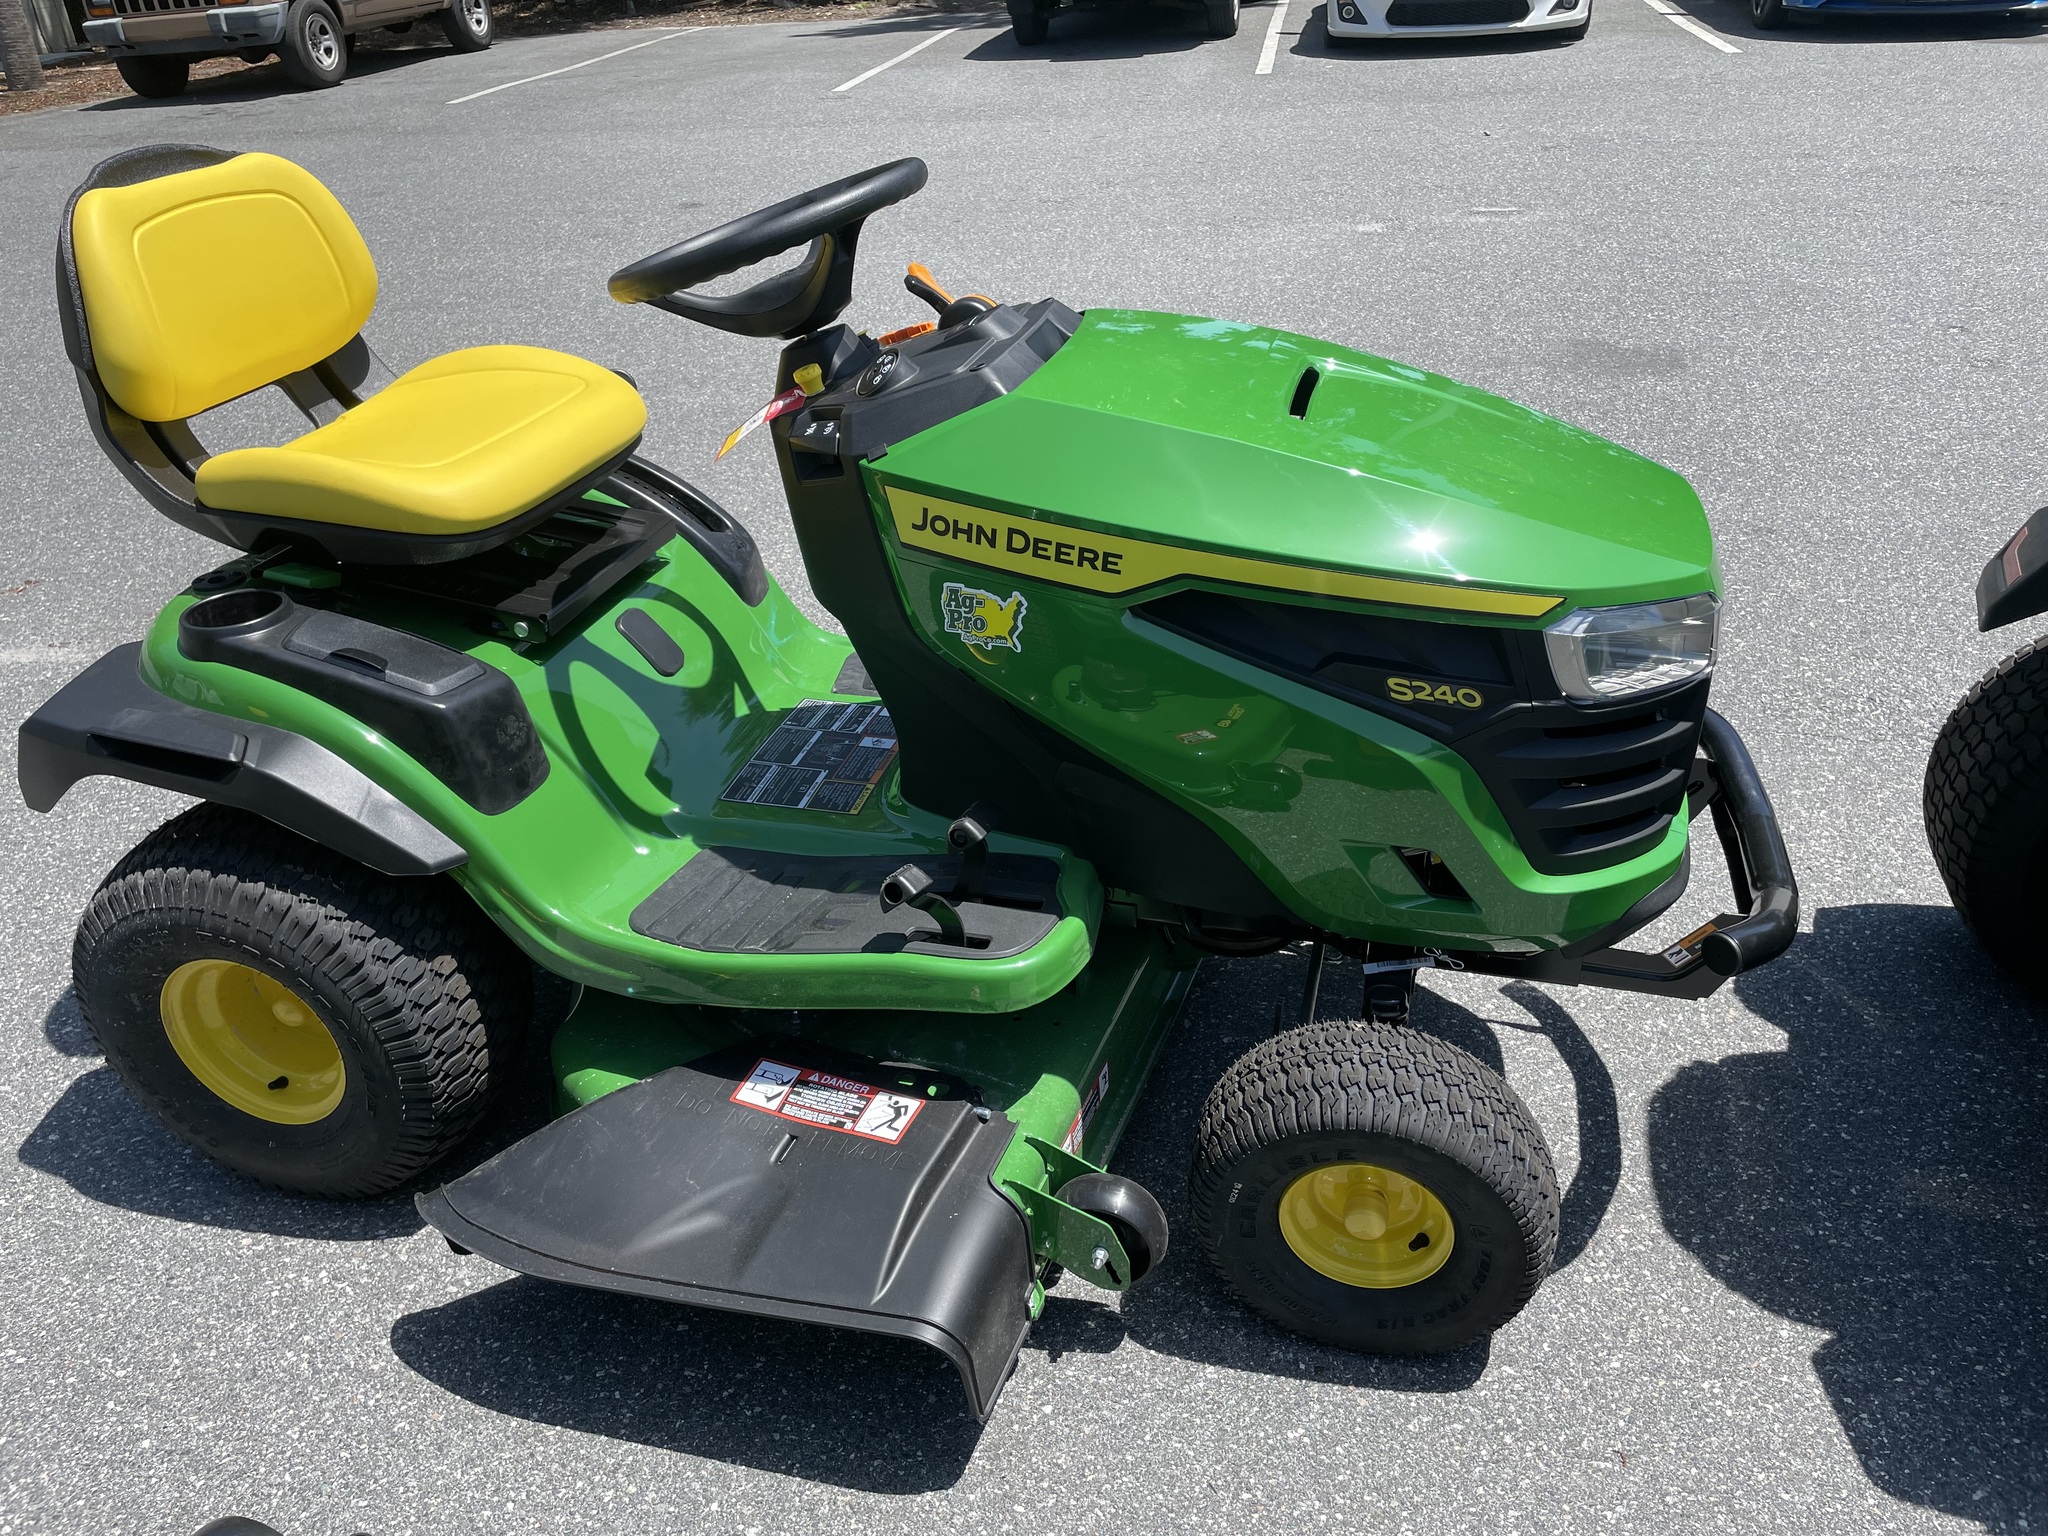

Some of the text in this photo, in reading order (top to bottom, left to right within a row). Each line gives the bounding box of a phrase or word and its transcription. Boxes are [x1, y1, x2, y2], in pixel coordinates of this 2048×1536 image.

[911, 507, 1124, 576] JOHN DEERE
[945, 587, 985, 615] Ag-
[948, 609, 988, 633] Pro
[963, 632, 1008, 645] AgProCo.com
[1386, 676, 1484, 709] S240
[820, 1075, 870, 1095] DANGER
